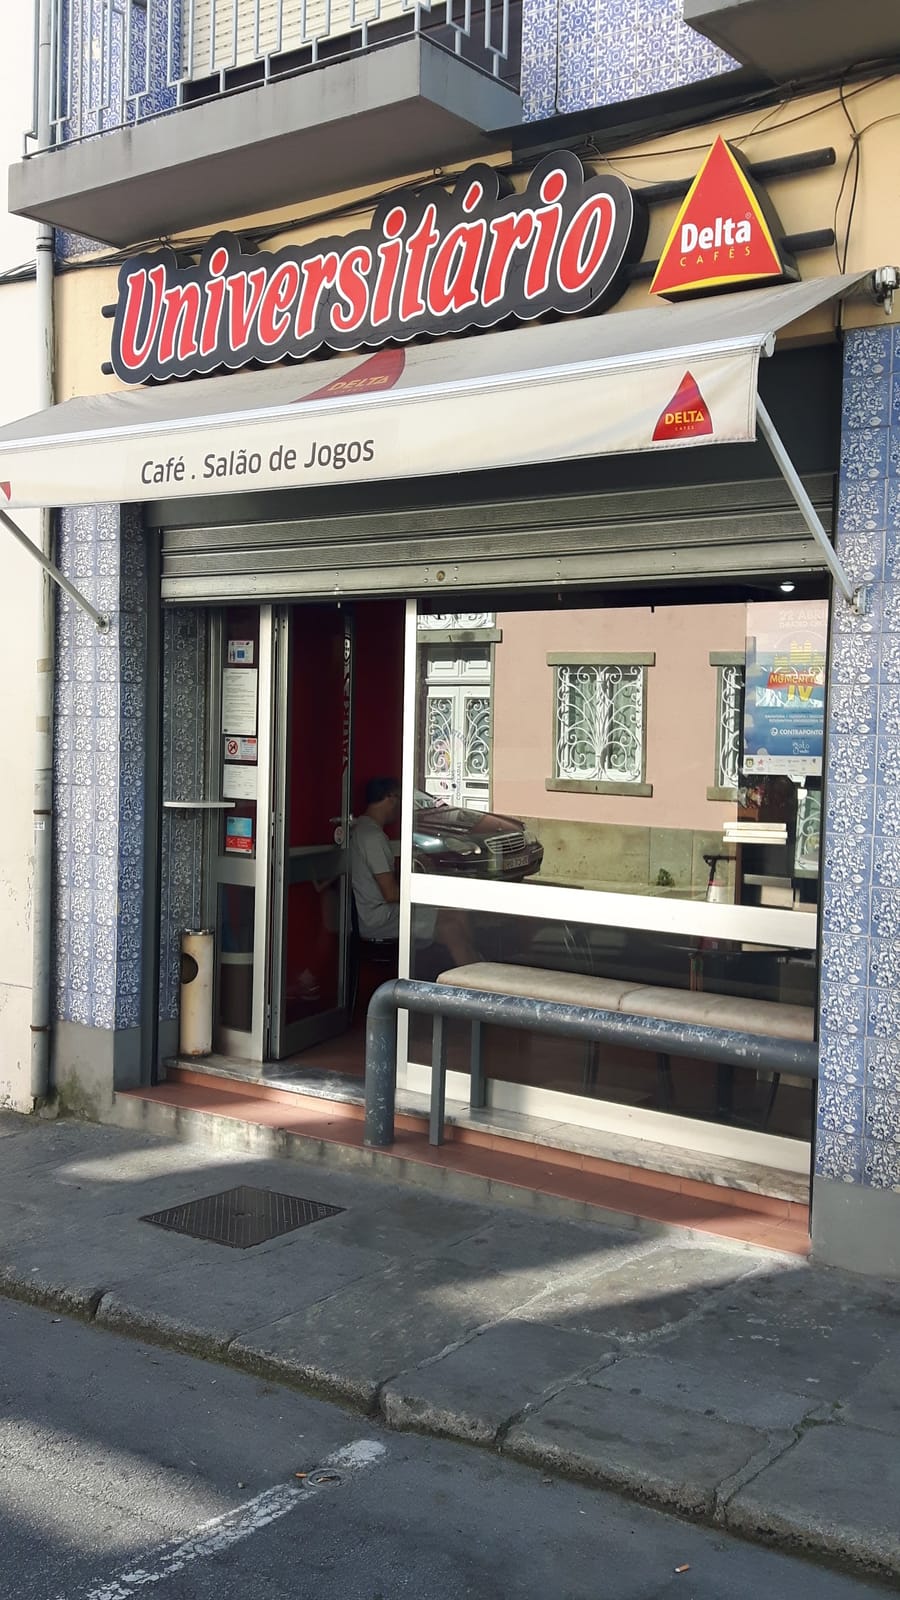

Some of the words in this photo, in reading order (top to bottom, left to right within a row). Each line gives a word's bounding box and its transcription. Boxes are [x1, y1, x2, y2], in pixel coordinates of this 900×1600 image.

[680, 217, 752, 254] Delta
[119, 167, 616, 370] Universitário
[327, 375, 390, 391] DELTA
[664, 410, 705, 425] DELTA
[141, 455, 186, 485] Café
[203, 448, 262, 479] Salão
[269, 445, 297, 472] de
[304, 439, 375, 470] Jogos
